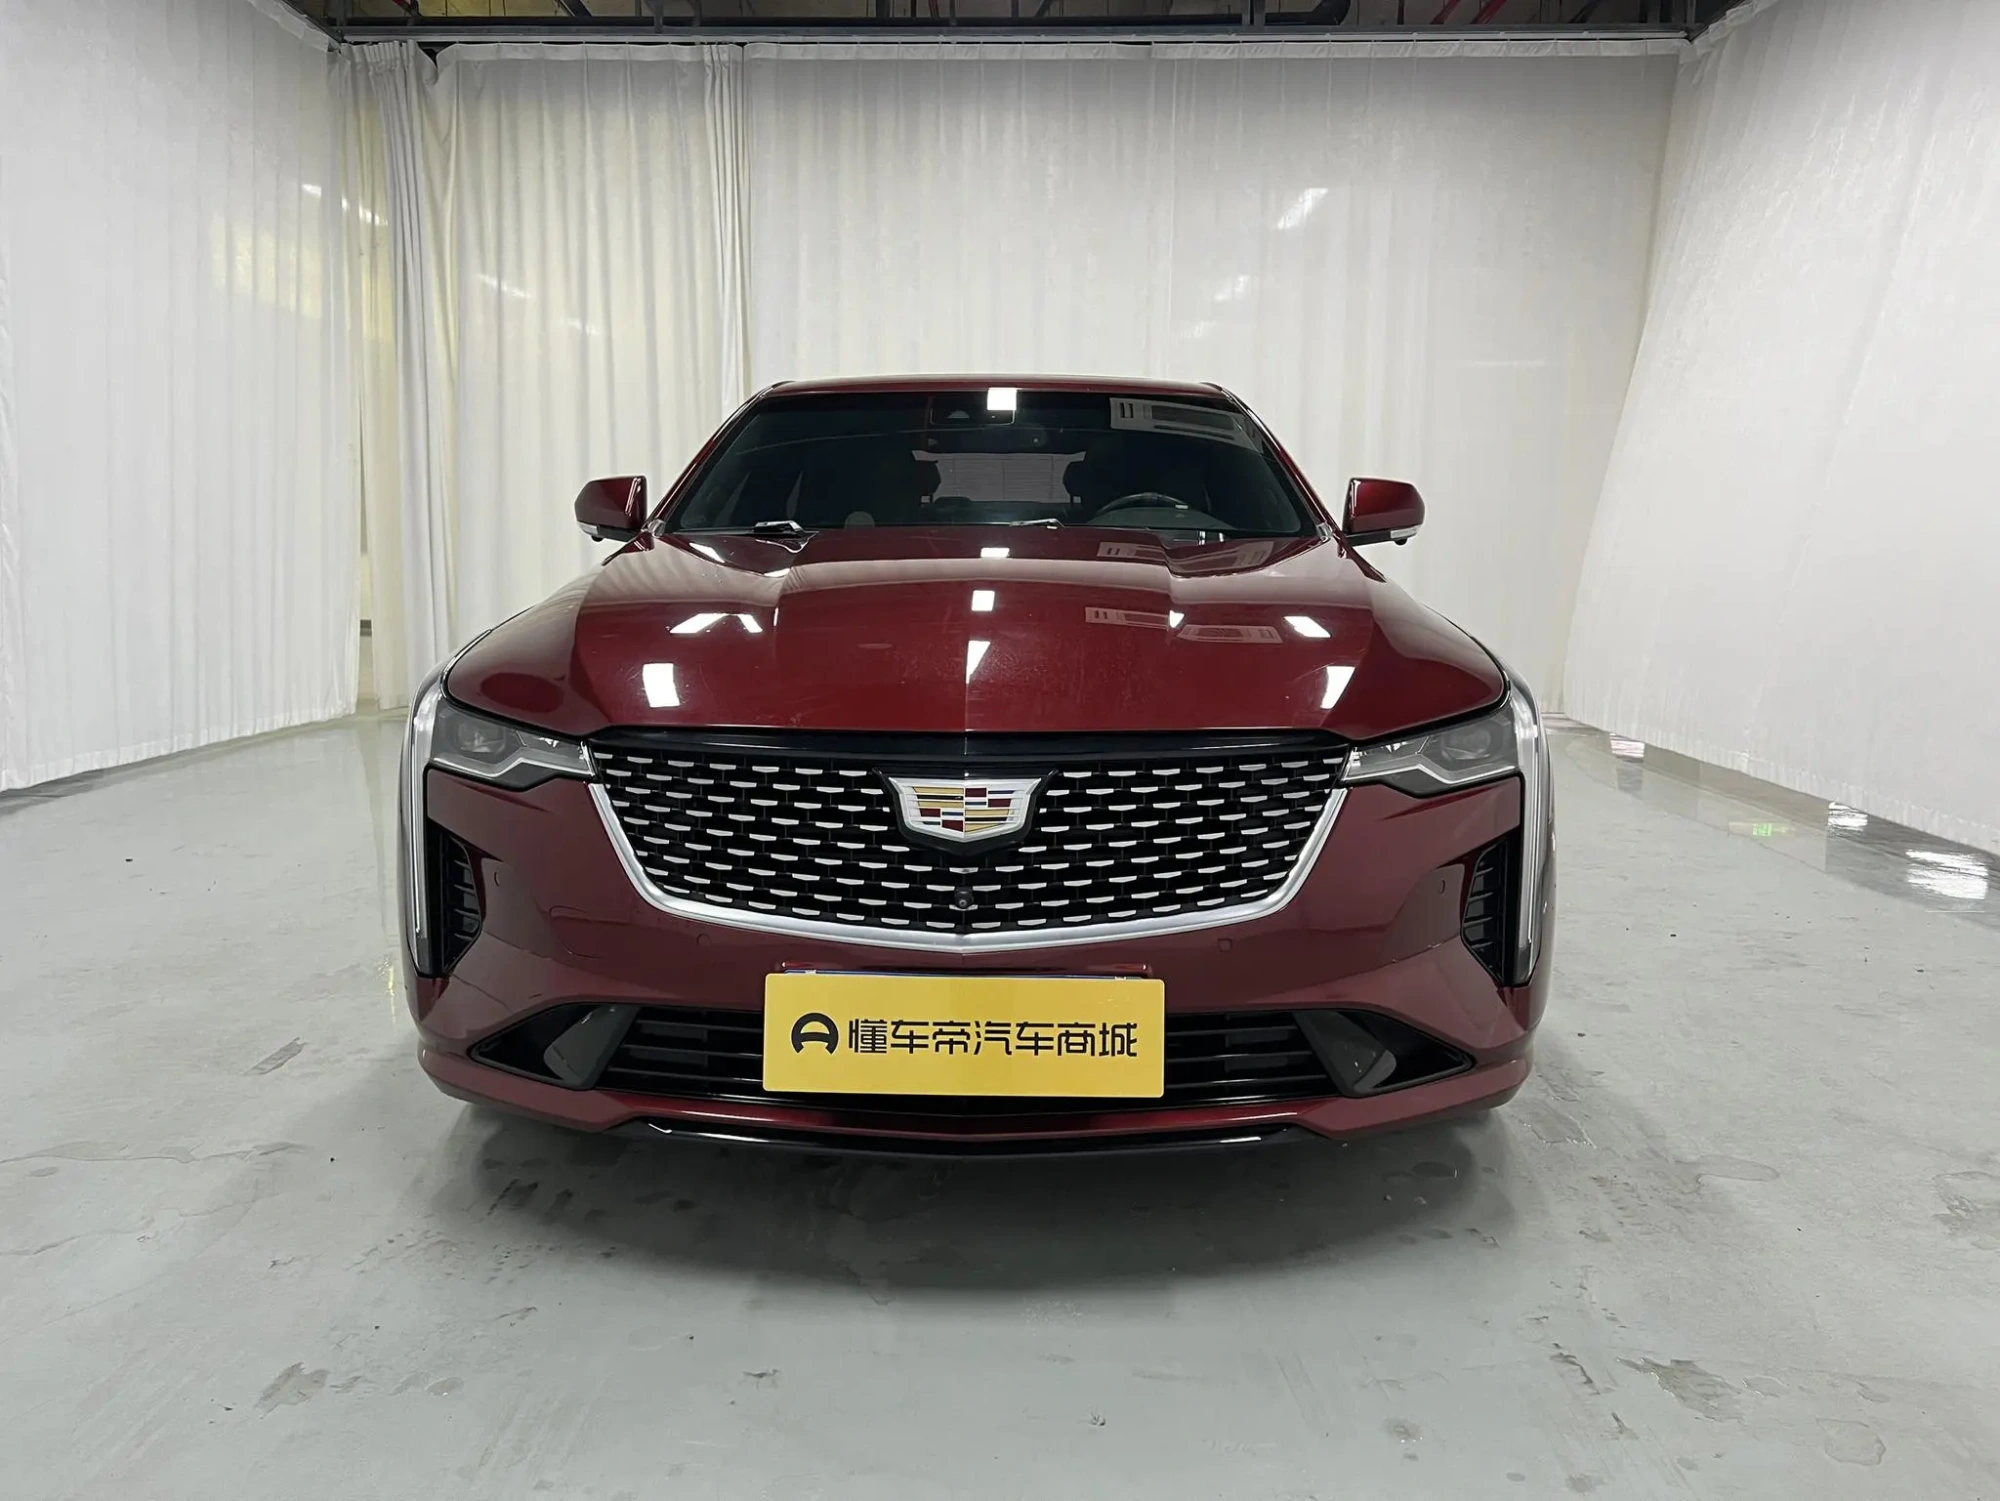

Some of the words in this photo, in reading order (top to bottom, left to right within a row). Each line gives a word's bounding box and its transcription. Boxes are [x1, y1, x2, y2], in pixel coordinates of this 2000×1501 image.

[848, 1018, 1138, 1058] 懂车帝汽车商城
